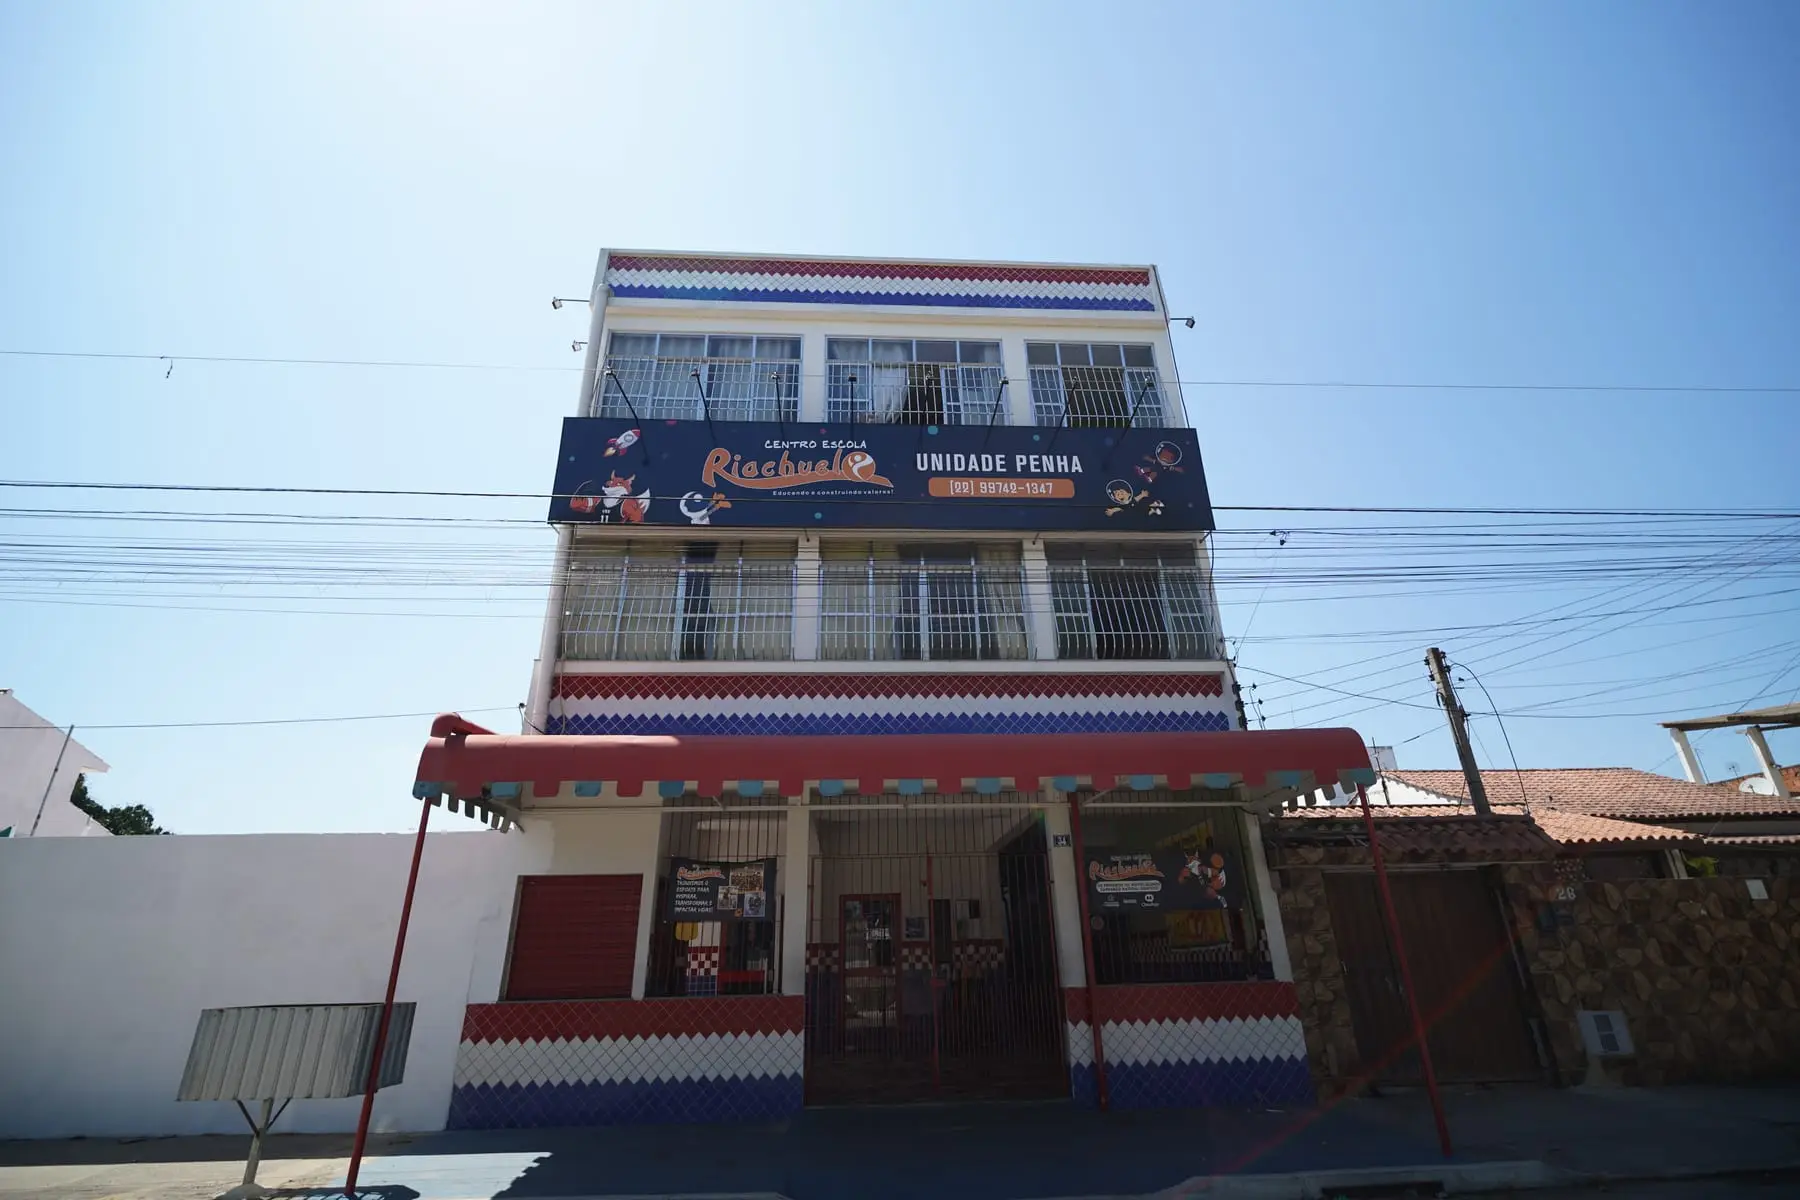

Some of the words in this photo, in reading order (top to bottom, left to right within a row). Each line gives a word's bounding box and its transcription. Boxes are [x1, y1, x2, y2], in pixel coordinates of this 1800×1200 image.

[764, 439, 817, 449] CENTRO
[822, 439, 867, 449] ESCOLA
[701, 447, 894, 489] Riachuelo
[916, 453, 1006, 473] UNIDADE
[1016, 454, 1083, 474] PENHA
[980, 482, 1053, 494] 99742-1347
